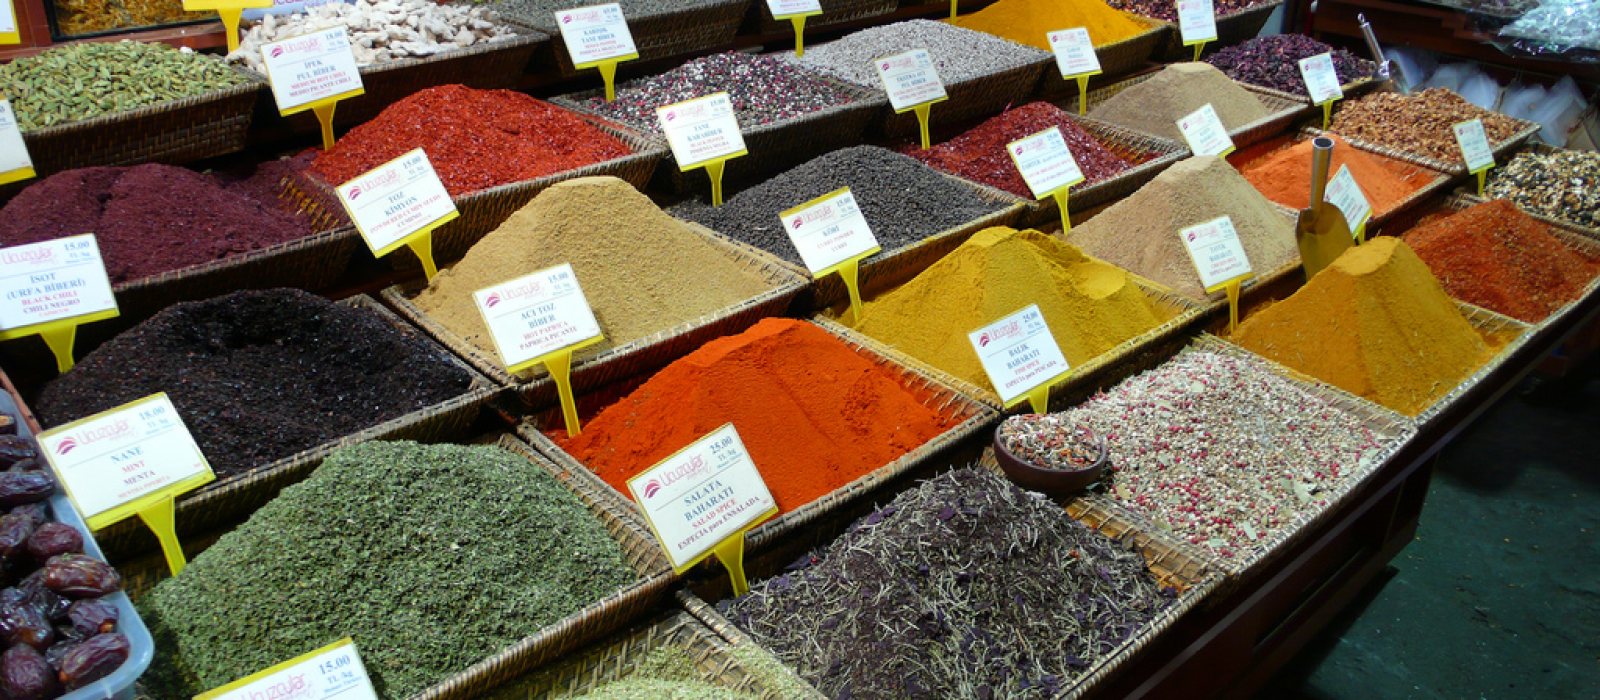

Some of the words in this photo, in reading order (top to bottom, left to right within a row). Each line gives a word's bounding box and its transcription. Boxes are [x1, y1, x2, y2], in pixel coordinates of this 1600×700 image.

[296, 70, 312, 80] PUL
[313, 65, 336, 76] BİBER
[304, 60, 322, 70] İPEK
[388, 191, 404, 204] TOZ
[538, 303, 556, 314] TOZ
[528, 314, 556, 328] BİBER
[1007, 349, 1040, 370] BAHARATI
[709, 436, 734, 454] 25.00
[111, 446, 144, 462] NANE
[122, 460, 145, 474] MINT
[124, 470, 156, 484] MENTA
[684, 480, 722, 506] SALATA
[684, 486, 734, 521] BAHARATI
[692, 510, 717, 528] SALAD
[716, 498, 737, 518] SPICE
[678, 530, 709, 550] ESPECIA
[709, 518, 724, 533] para
[723, 496, 760, 524] ENSALADA
[319, 654, 350, 675] 15.00
